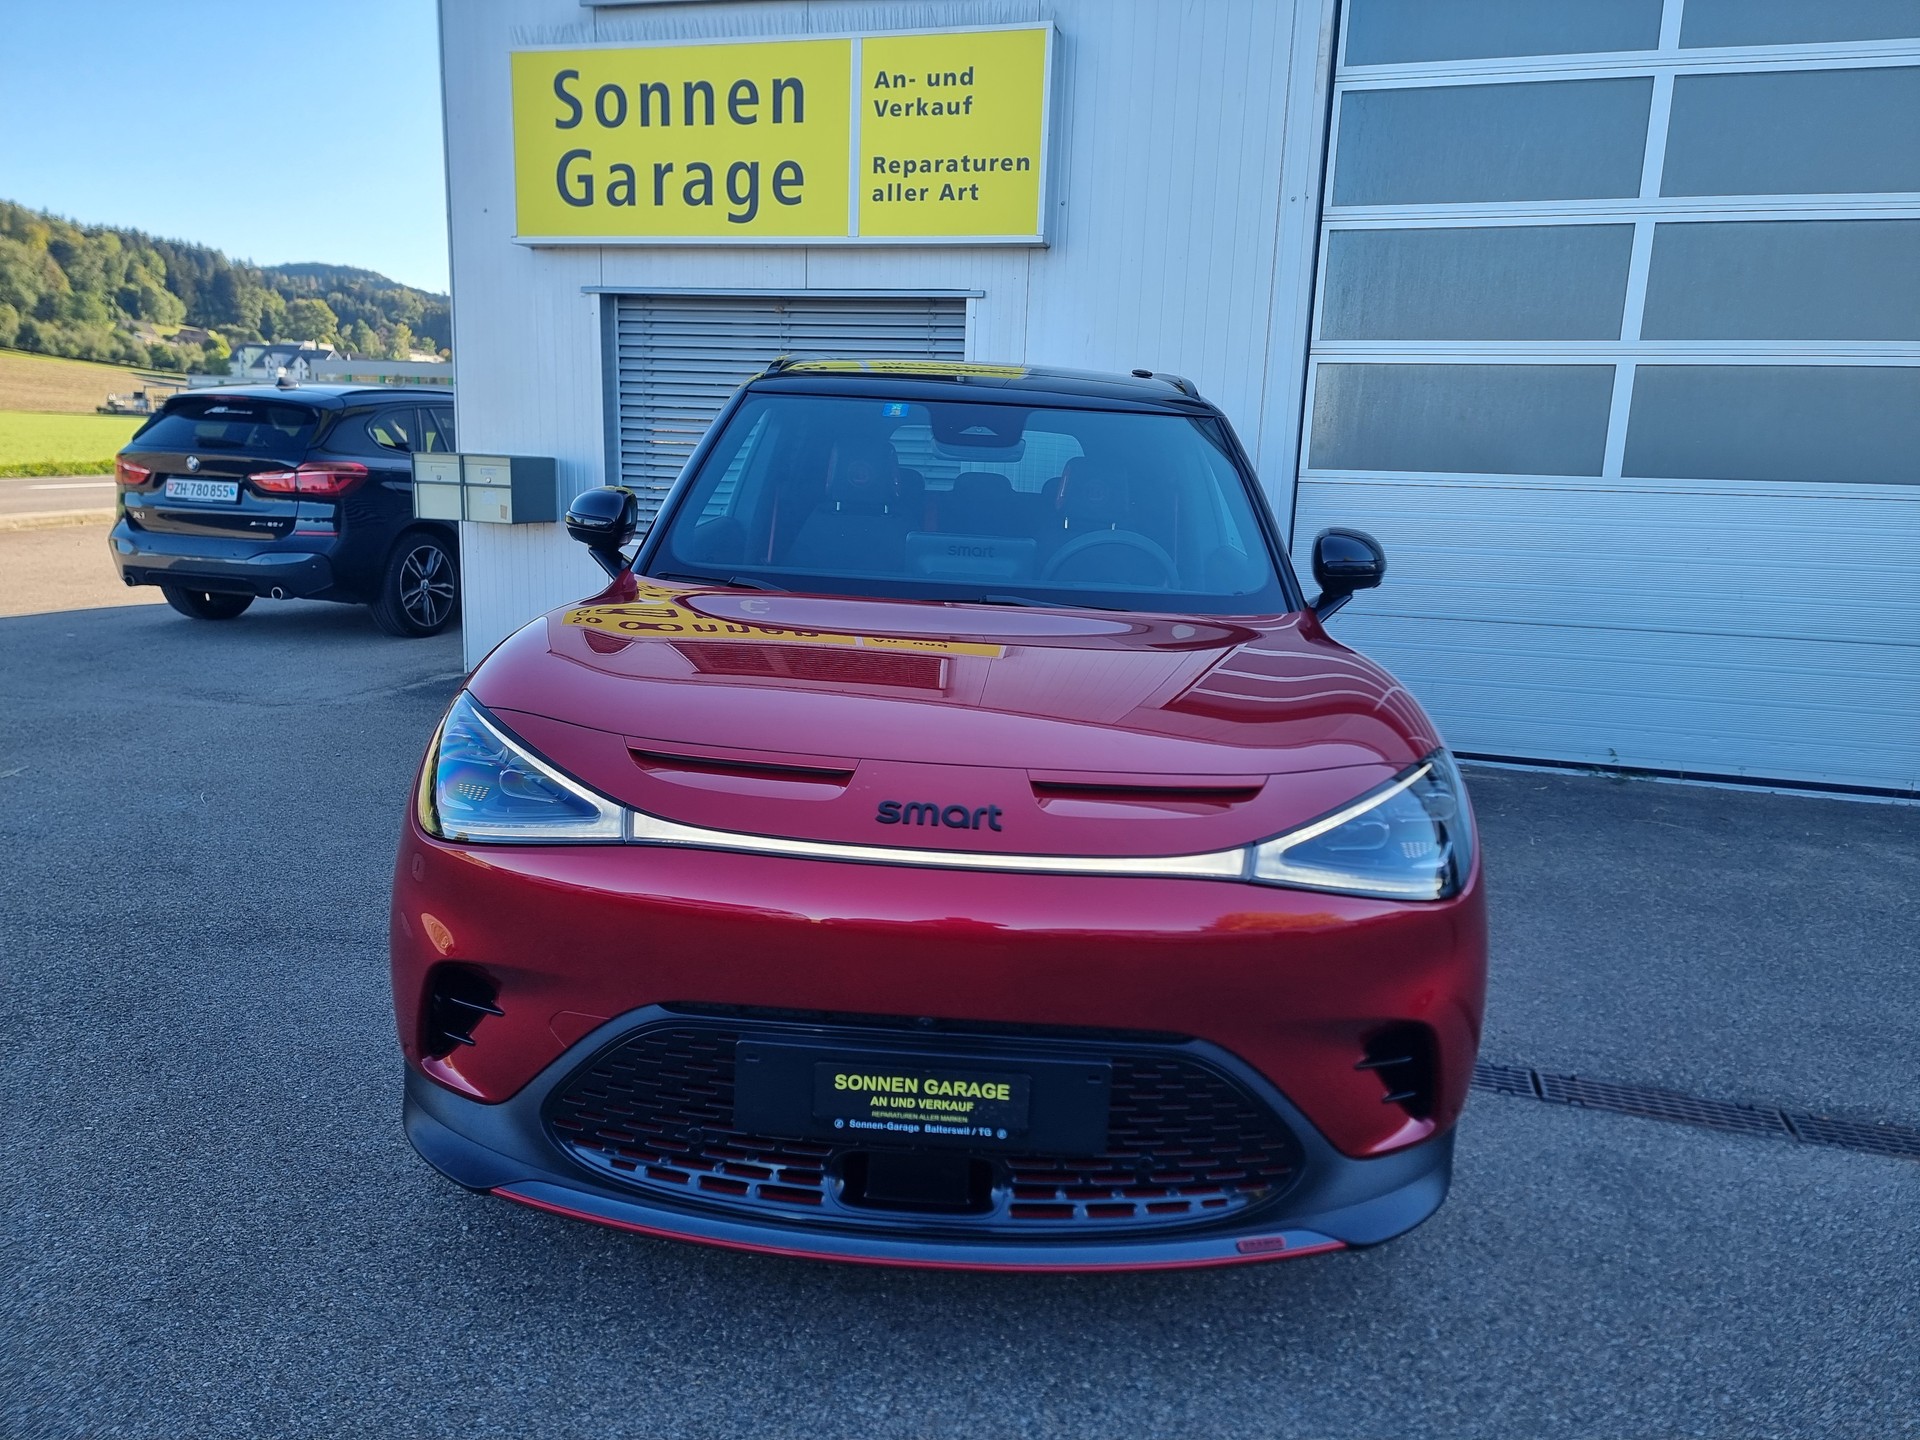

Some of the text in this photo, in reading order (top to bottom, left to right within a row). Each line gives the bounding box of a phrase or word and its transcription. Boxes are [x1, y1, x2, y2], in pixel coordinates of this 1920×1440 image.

[873, 66, 974, 89] An- und
[553, 68, 805, 130] Sonnen
[873, 95, 973, 118] Verkauf
[872, 154, 1031, 178] Reparaturen
[555, 148, 805, 224] Garage
[871, 182, 980, 202] aller Art
[947, 545, 995, 558] smart
[875, 800, 1003, 832] smart
[834, 1073, 1010, 1101] SONNEN GARAGE
[870, 1095, 975, 1112] AN UND VERKAUF
[849, 1118, 920, 1133] Sonnen-Garage
